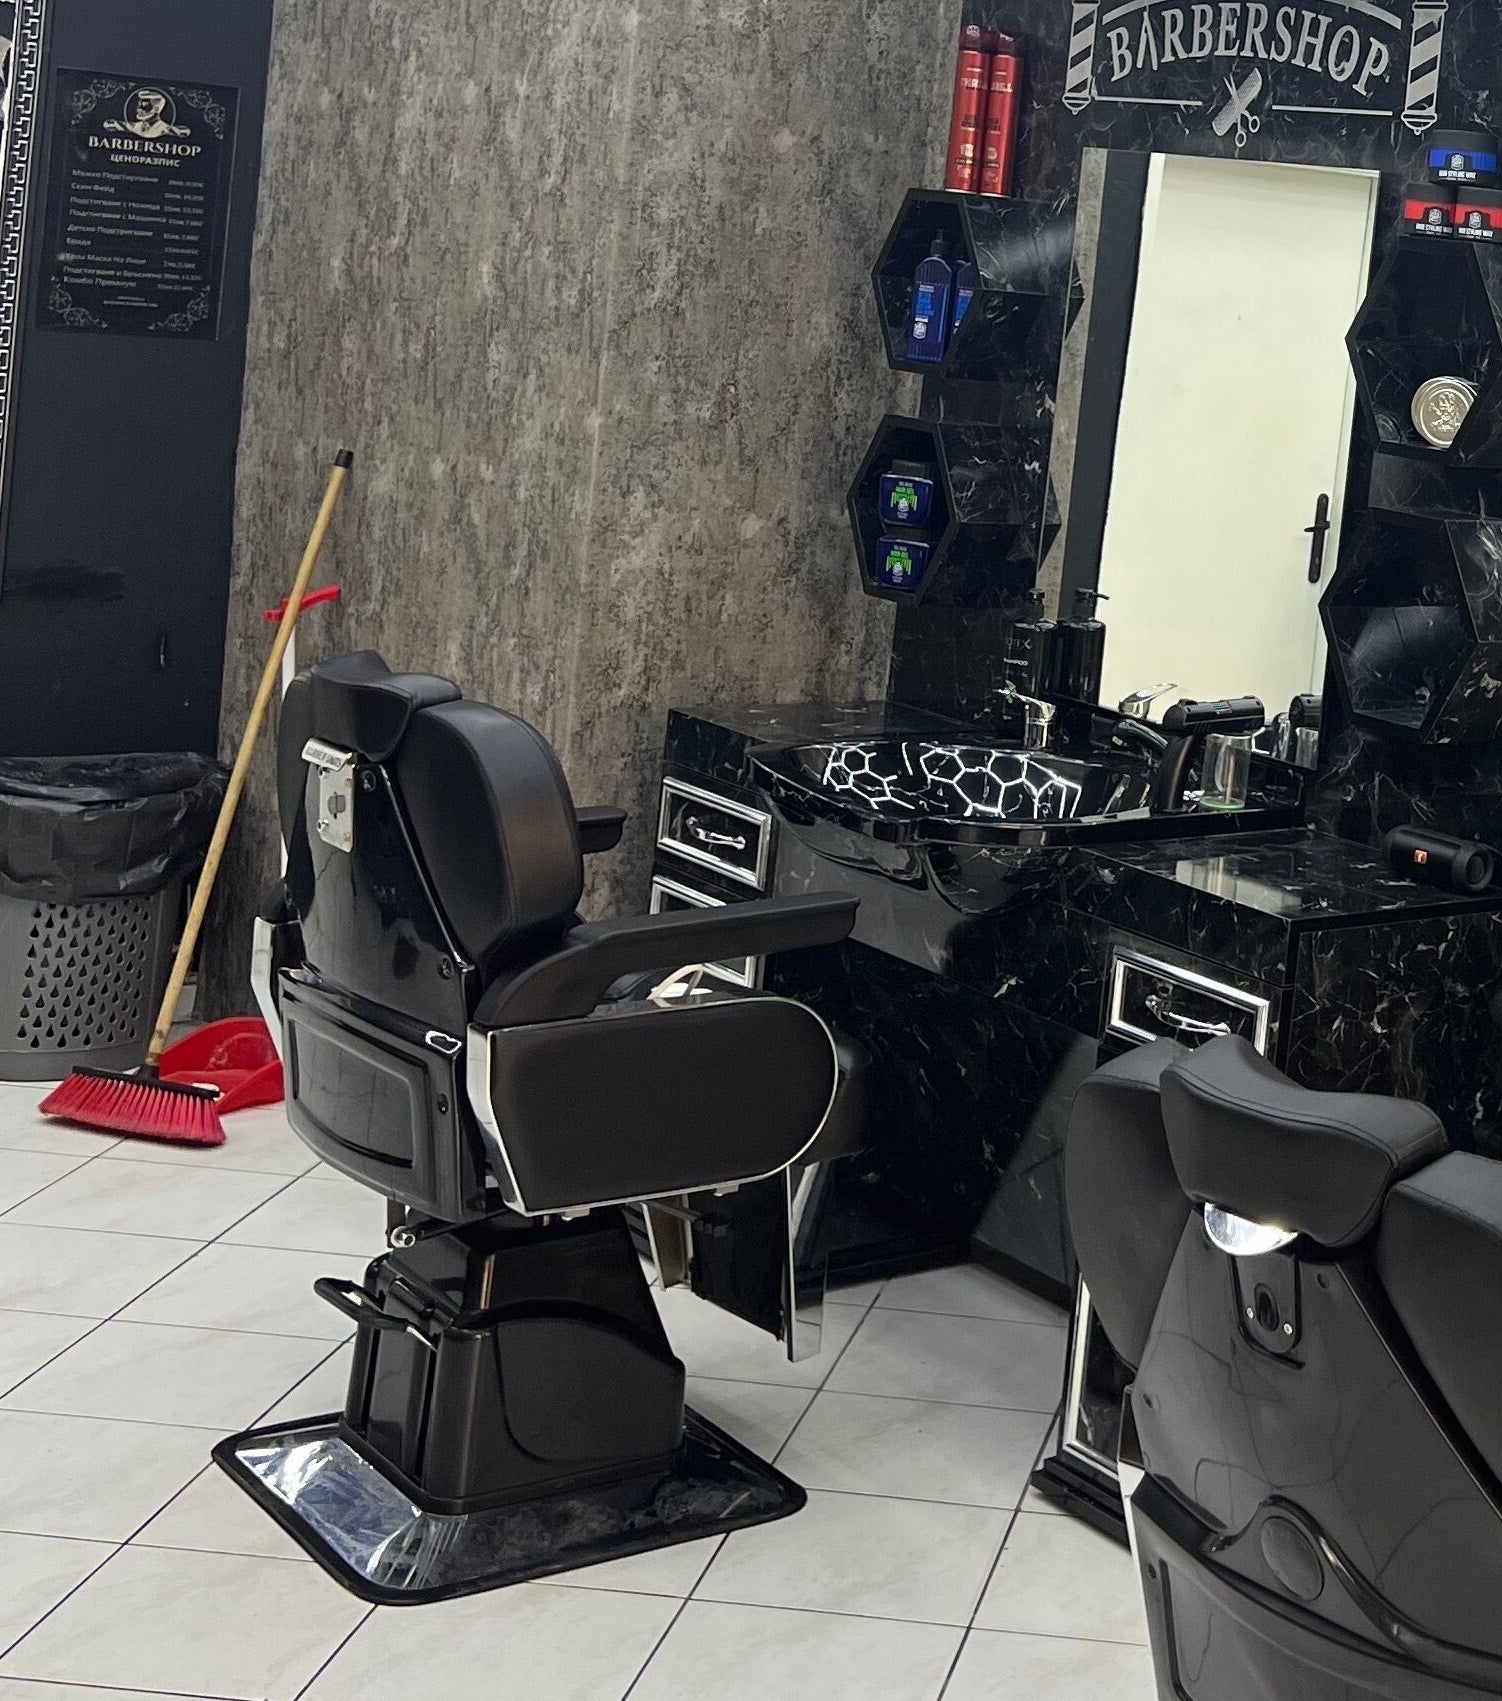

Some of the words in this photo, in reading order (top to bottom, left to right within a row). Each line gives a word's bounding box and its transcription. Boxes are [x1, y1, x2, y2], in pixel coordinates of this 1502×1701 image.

[1107, 2, 1390, 97] BARBERSHOP
[88, 135, 201, 156] BARBERSHOP
[110, 153, 180, 167] ЦЕНОРАЗПИС
